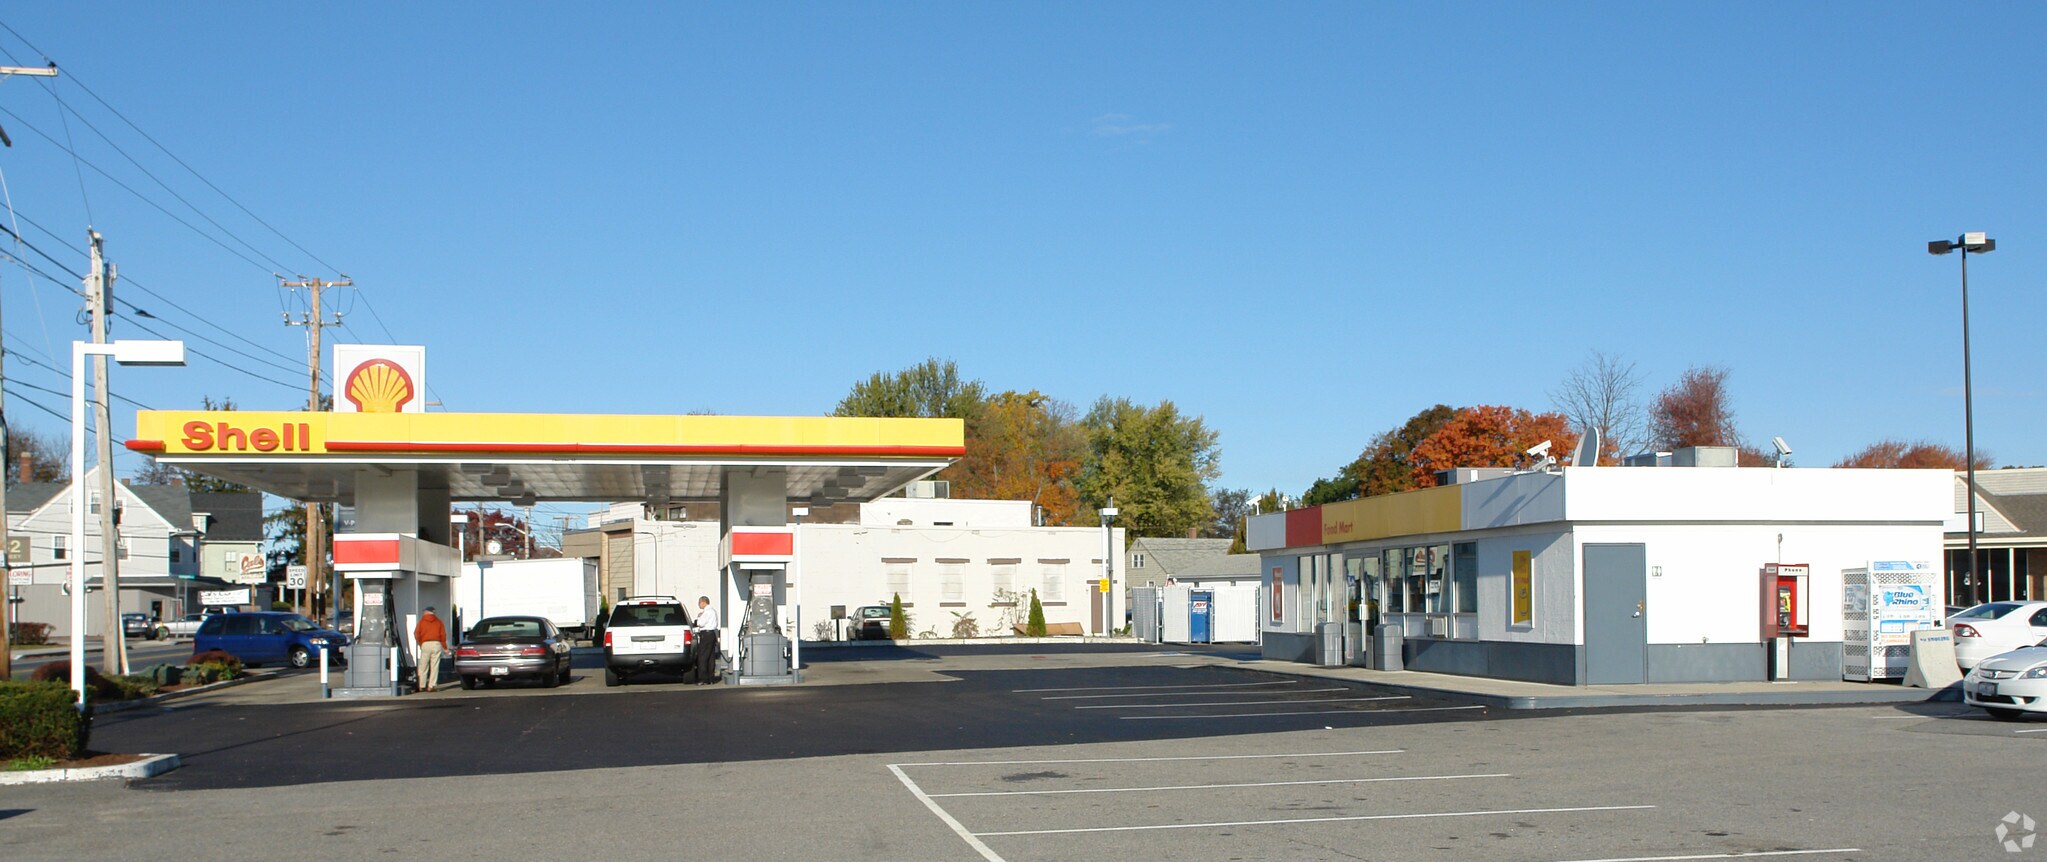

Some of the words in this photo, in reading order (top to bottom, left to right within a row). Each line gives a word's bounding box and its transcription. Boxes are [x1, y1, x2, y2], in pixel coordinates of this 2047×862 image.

[181, 420, 310, 451] Shell
[1324, 521, 1338, 535] Food
[1339, 521, 1354, 534] Mart
[289, 577, 304, 586] 30
